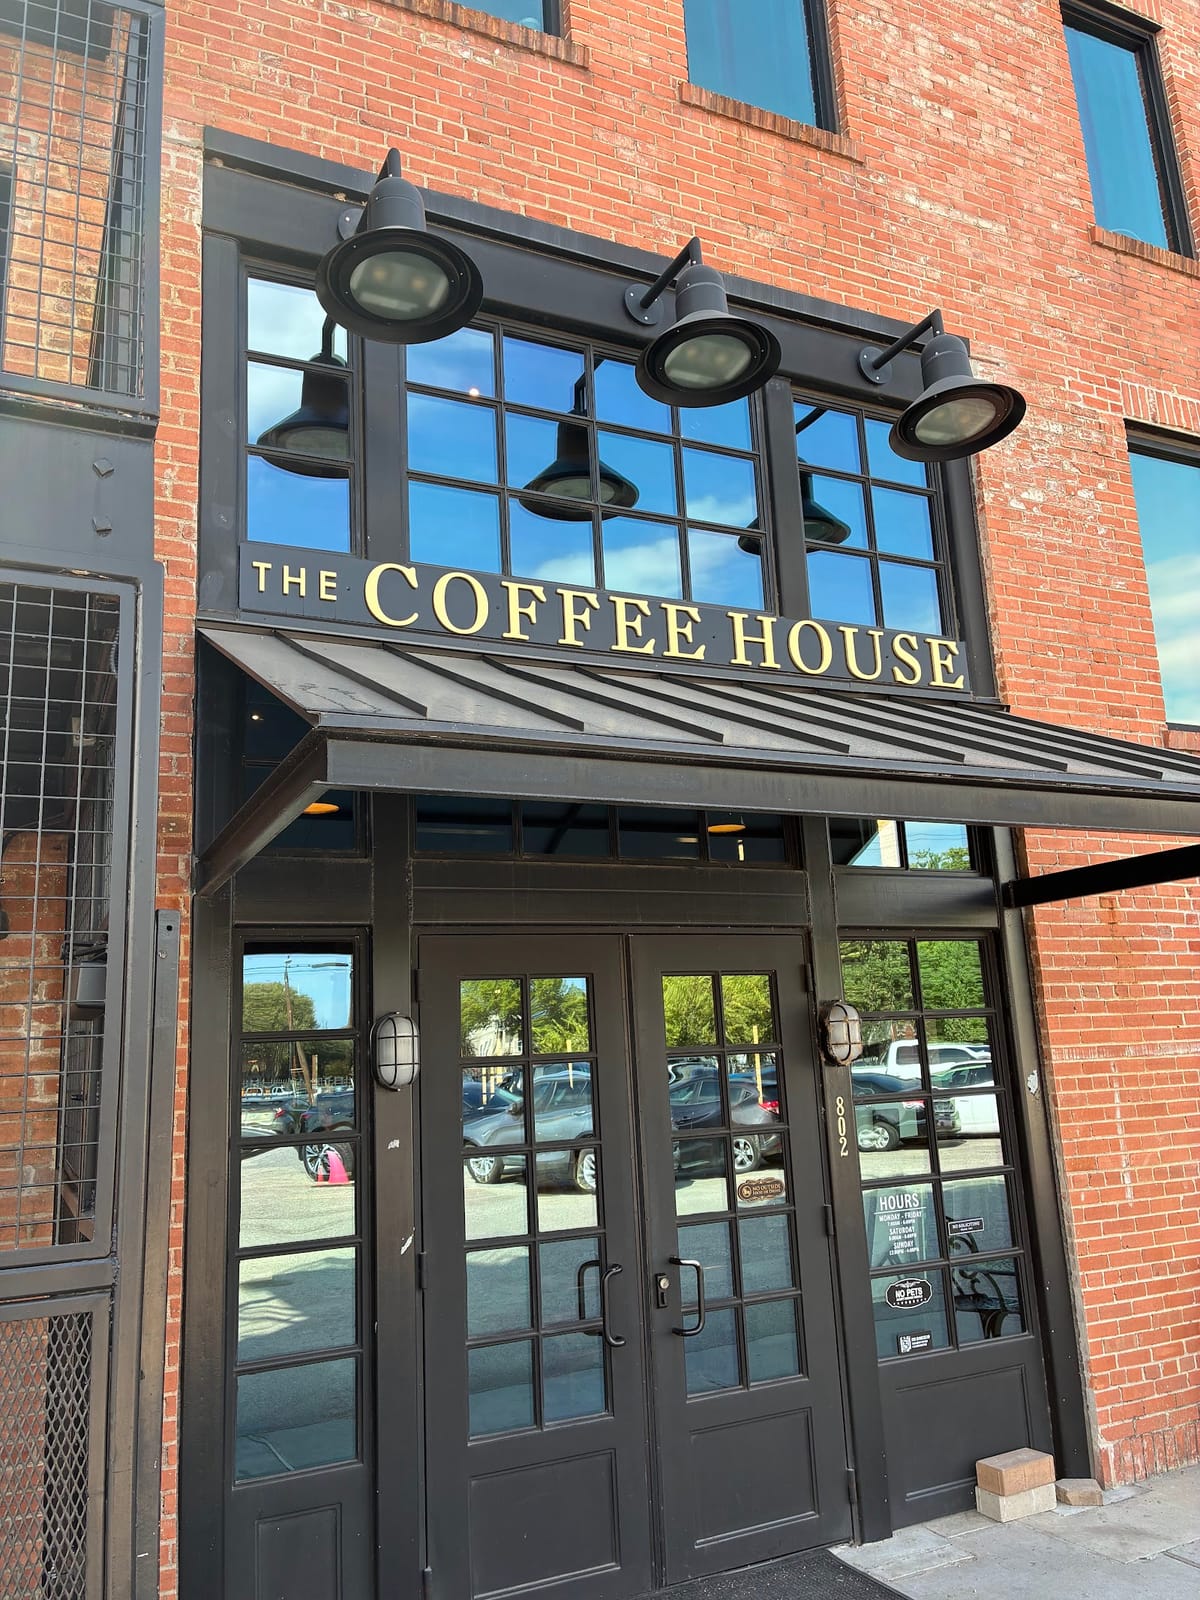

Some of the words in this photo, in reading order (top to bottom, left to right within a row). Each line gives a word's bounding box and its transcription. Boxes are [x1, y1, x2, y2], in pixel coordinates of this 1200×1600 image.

[252, 561, 338, 601] THE
[364, 562, 706, 660] COFFEE
[726, 611, 965, 689] HOUSE
[836, 1096, 849, 1157] 802
[880, 1193, 919, 1211] HOURS
[879, 1213, 900, 1222] MONDAY
[904, 1210, 922, 1220] FRIDAY
[890, 1226, 915, 1236] SATURDAY
[894, 1240, 914, 1250] SUNDAY
[895, 1289, 906, 1298] NO
[906, 1286, 923, 1297] PETS
